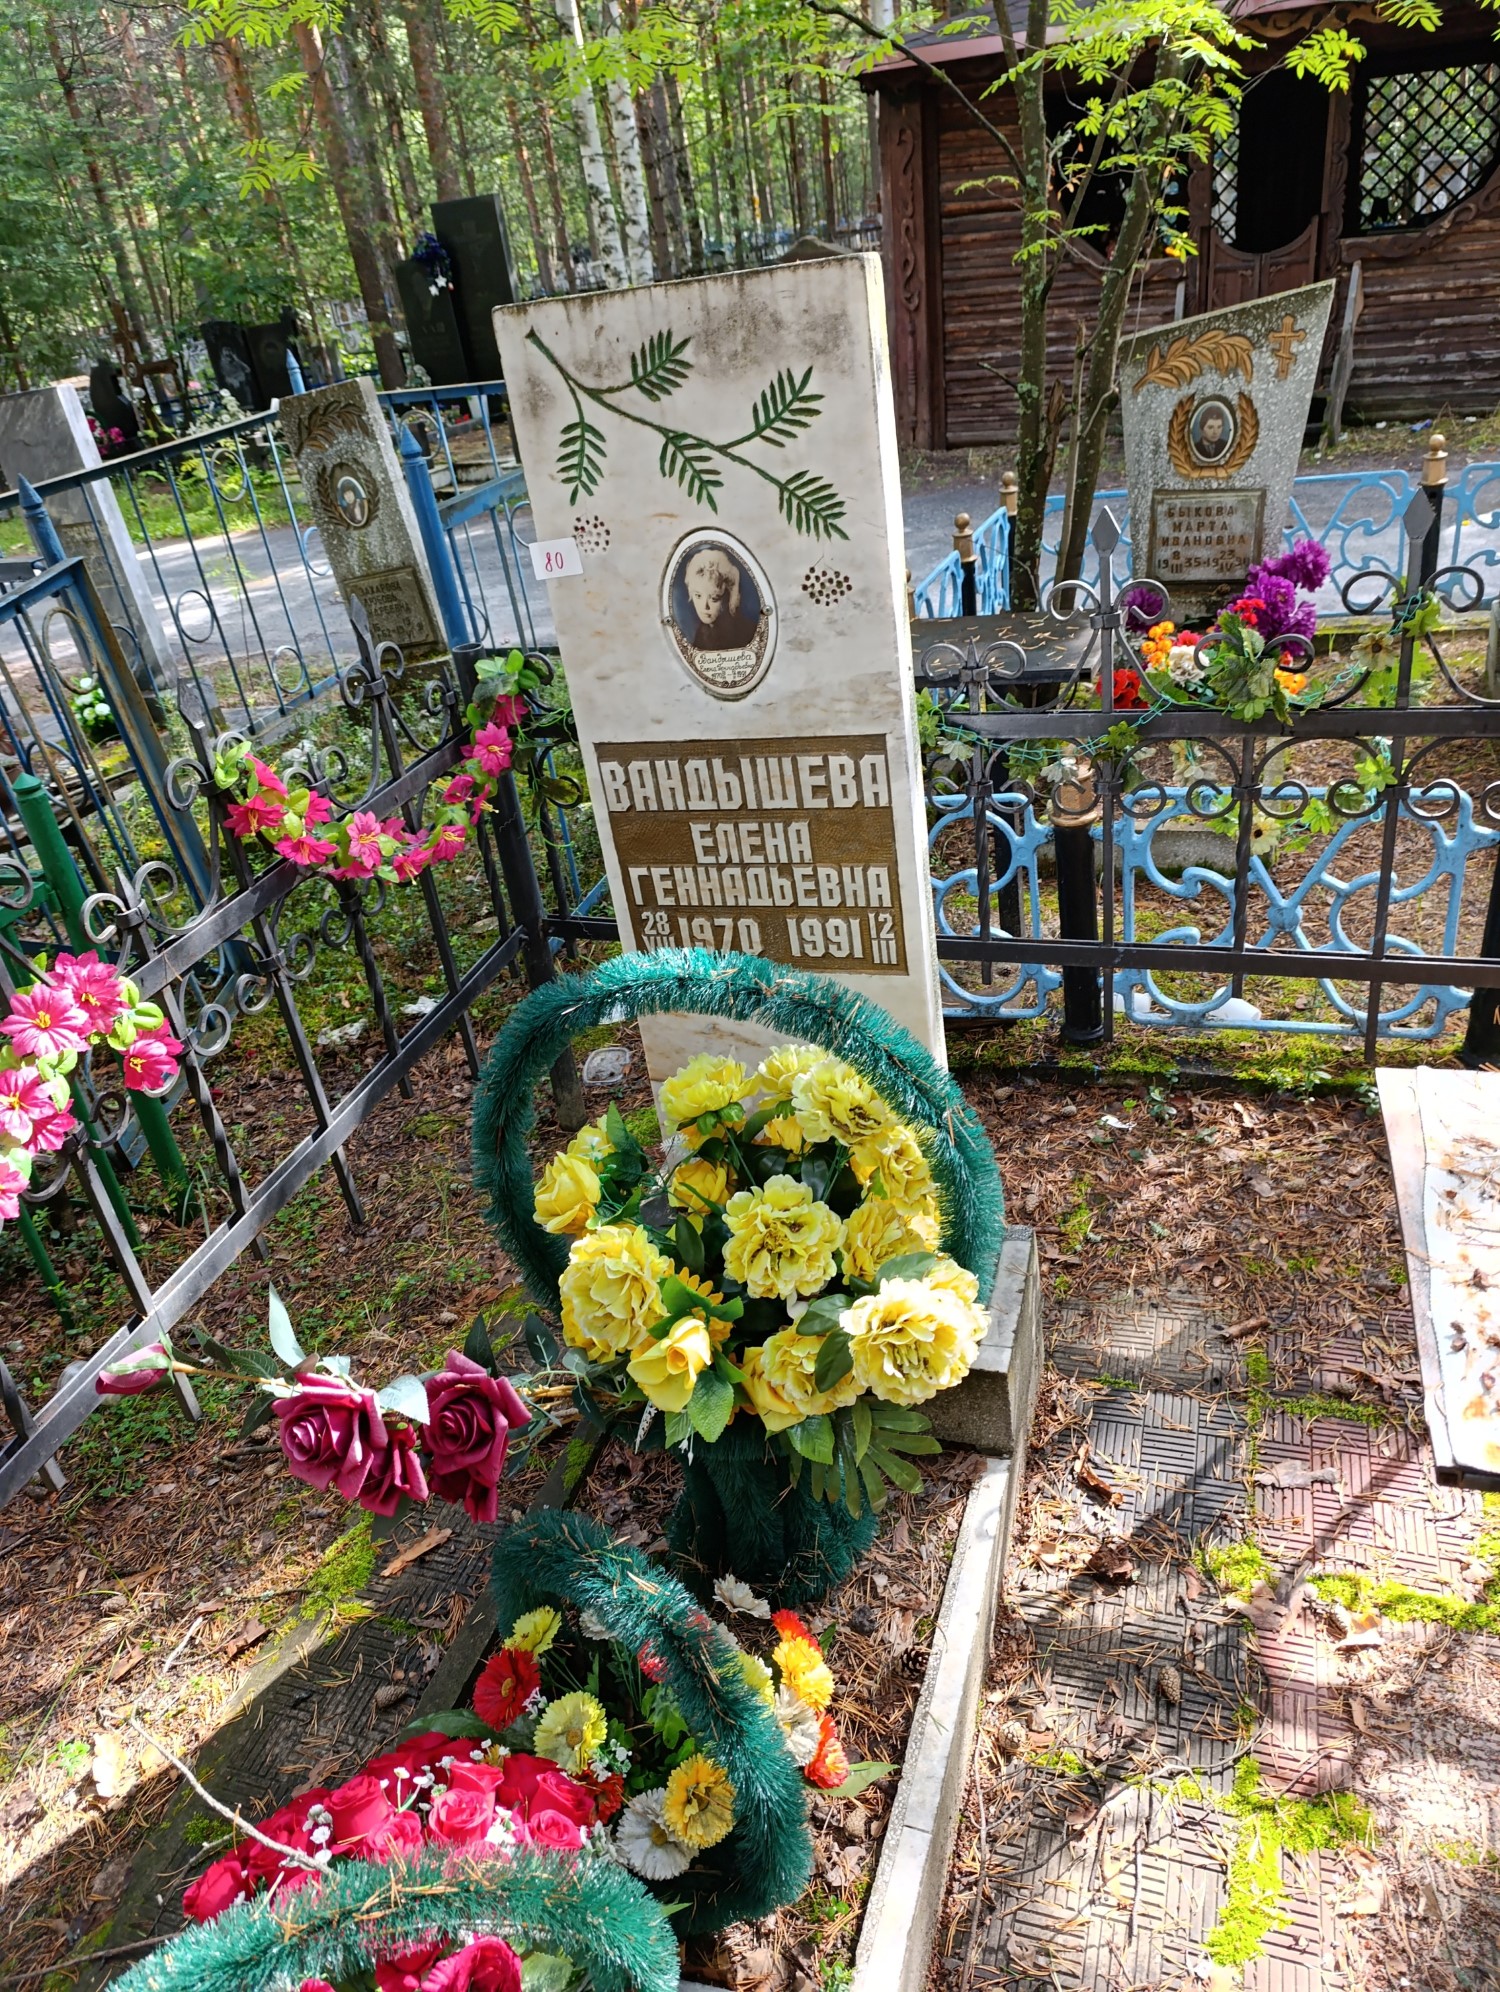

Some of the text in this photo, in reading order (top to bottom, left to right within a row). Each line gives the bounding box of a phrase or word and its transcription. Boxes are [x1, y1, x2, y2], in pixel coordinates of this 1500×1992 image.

[1167, 506, 1234, 518] БЫКОВА
[1172, 521, 1228, 532] МАРТА
[1161, 534, 1246, 547] ИВАНОВНА
[545, 551, 564, 573] 80
[600, 754, 890, 812] ВАНДЫШЕВА
[689, 820, 813, 864] ЕЛЕНА
[628, 865, 893, 908] ГЕННАДЬЕВНА
[641, 911, 895, 958] 28 1970 1991 12
[872, 940, 897, 964] III
